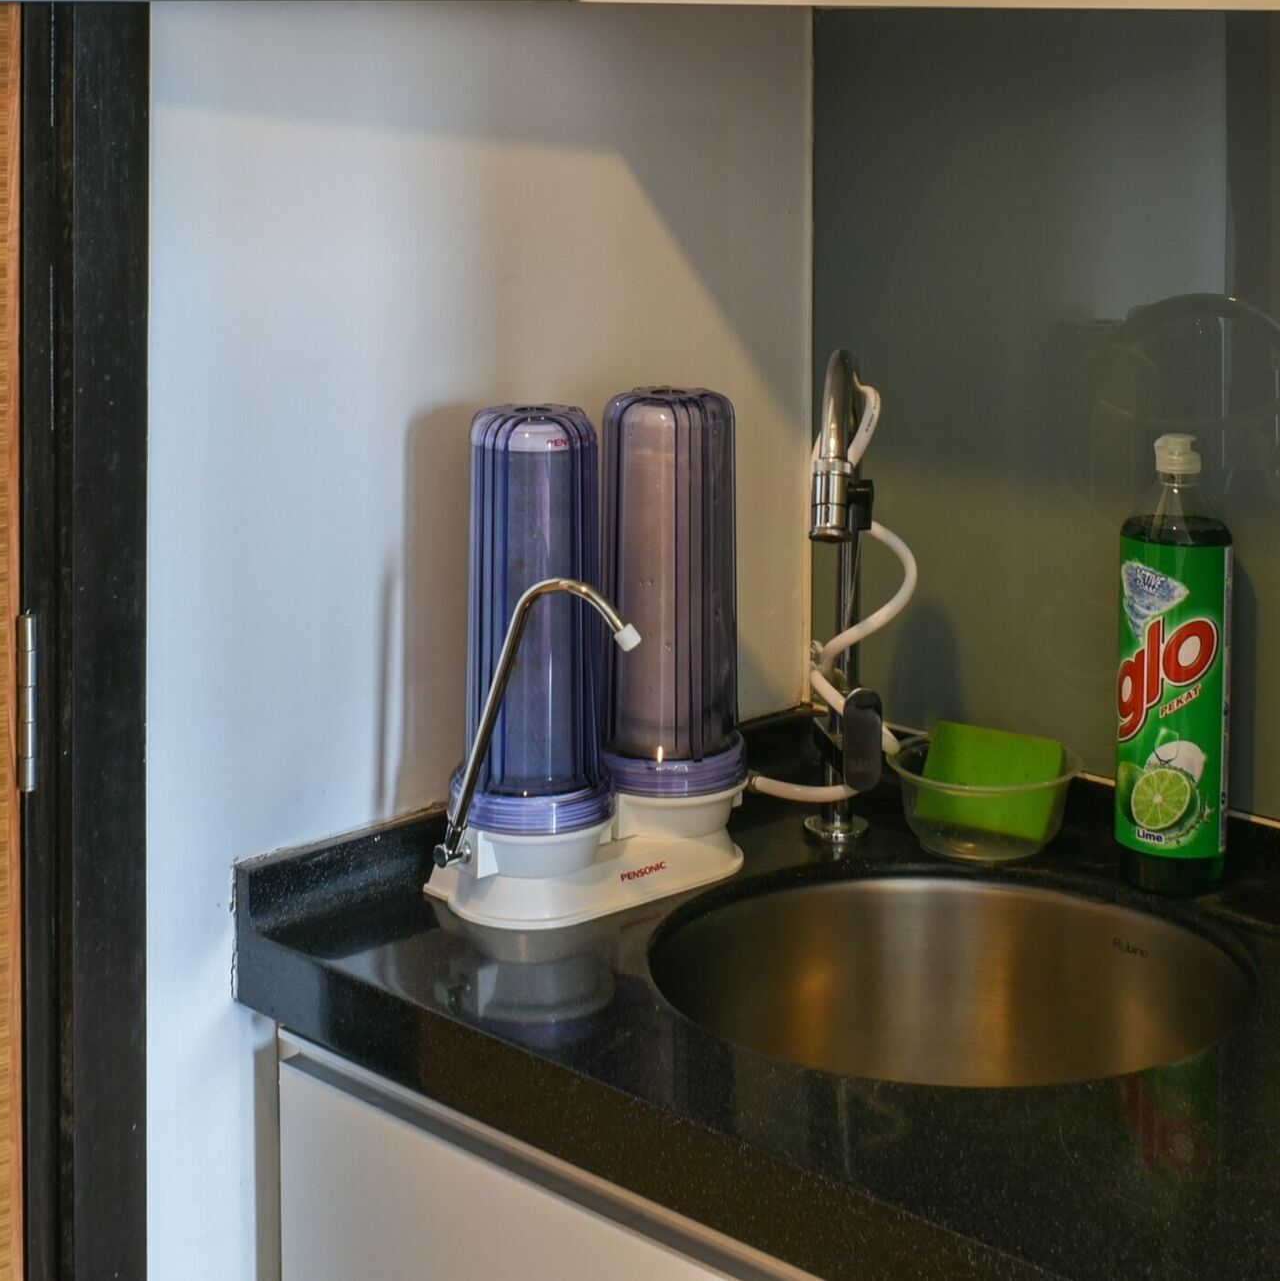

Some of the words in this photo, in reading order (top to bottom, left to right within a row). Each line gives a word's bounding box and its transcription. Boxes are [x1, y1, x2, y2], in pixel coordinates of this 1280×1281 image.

[1116, 616, 1219, 742] glo
[1159, 683, 1202, 719] PEKAT
[1136, 827, 1164, 844] Lime
[620, 860, 667, 883] PENSONIC
